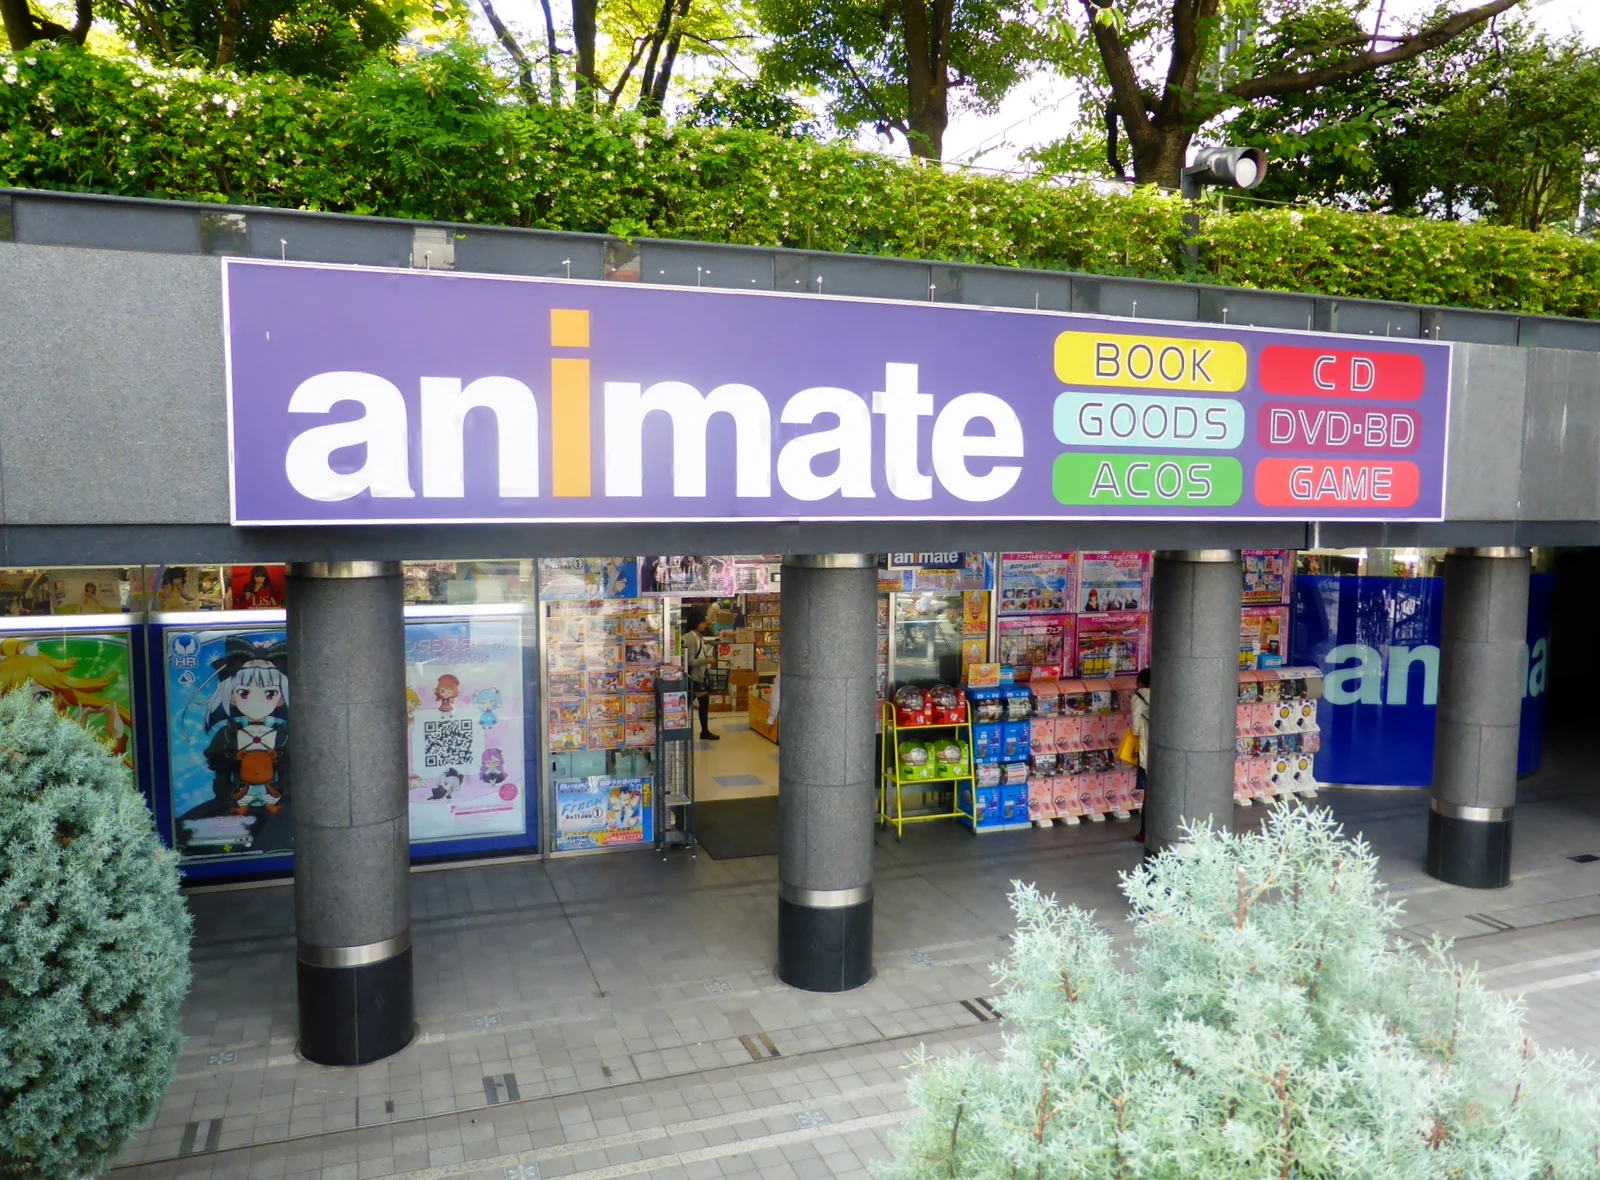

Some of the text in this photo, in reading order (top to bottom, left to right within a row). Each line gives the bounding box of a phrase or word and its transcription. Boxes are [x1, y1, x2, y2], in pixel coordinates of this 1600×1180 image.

[1094, 342, 1214, 383] BOOK
[285, 308, 1026, 502] animate
[1078, 402, 1228, 441] GOODS
[1089, 461, 1212, 499] ACOS
[1289, 465, 1393, 501] GAME
[894, 551, 959, 564] animate
[252, 596, 277, 606] LiSA
[174, 657, 198, 668] HR
